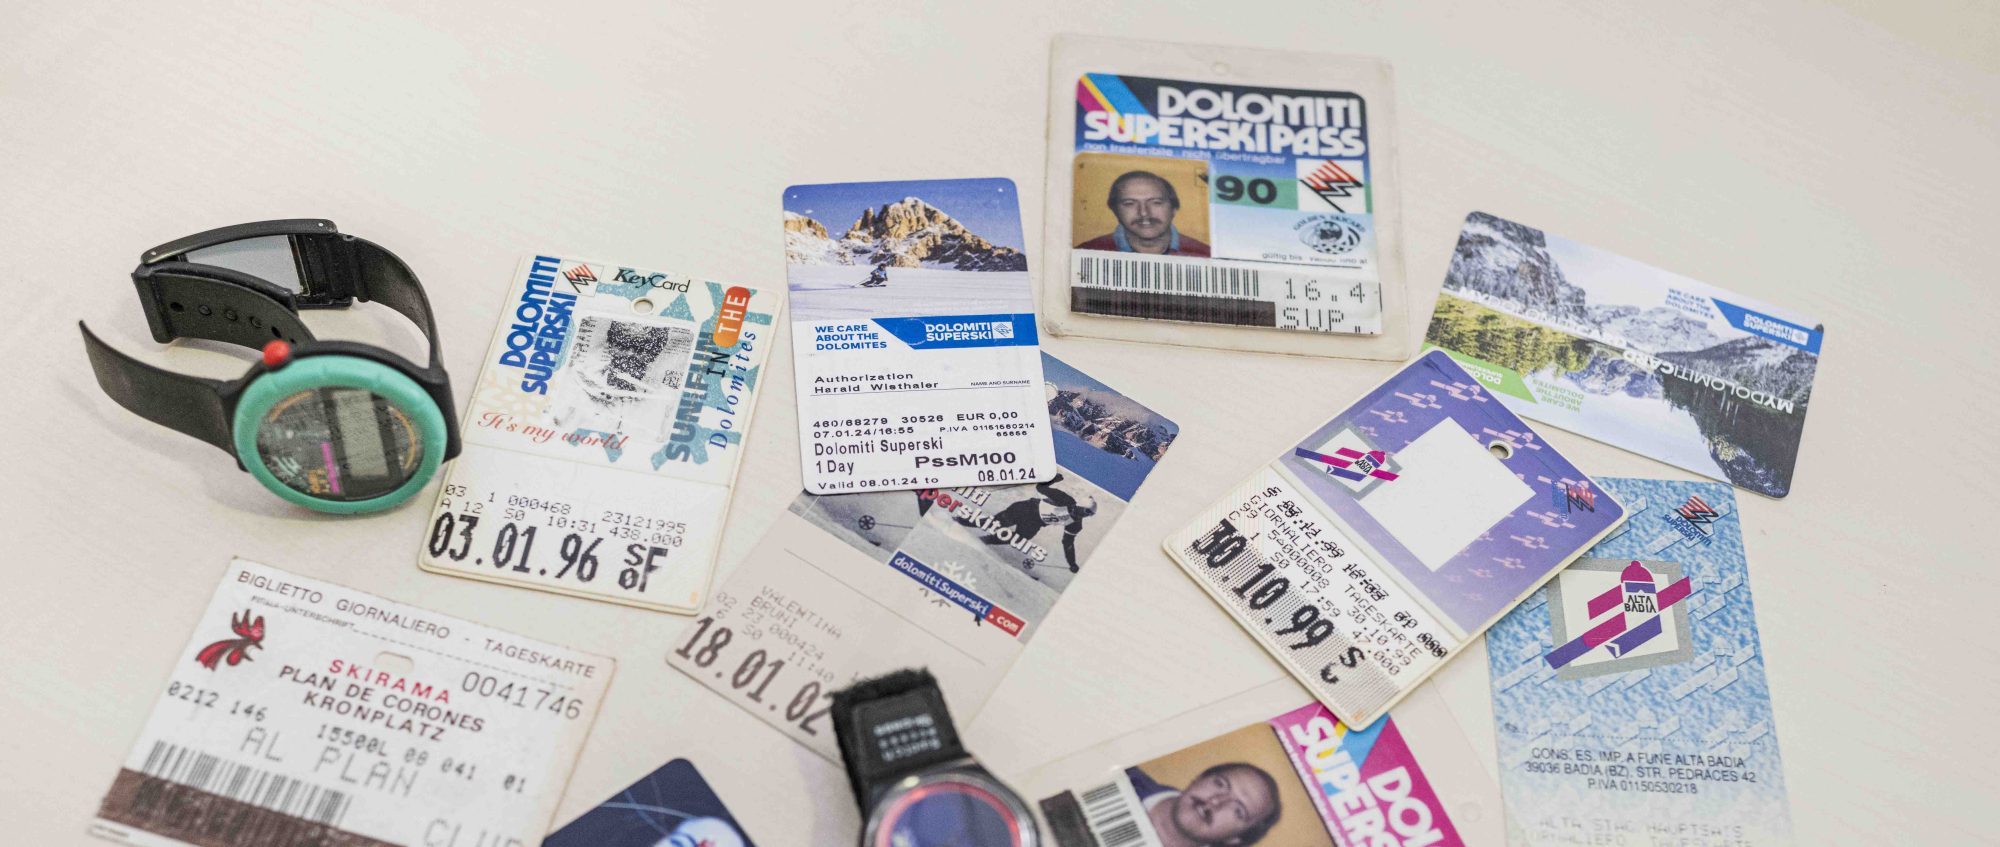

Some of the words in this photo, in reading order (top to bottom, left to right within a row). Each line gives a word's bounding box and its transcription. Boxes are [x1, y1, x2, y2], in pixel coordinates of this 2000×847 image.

[1157, 85, 1361, 128] DOLOMITI
[1215, 174, 1278, 205] 90
[611, 267, 692, 294] KeyCard
[499, 255, 562, 369] DOLOMITI
[718, 294, 748, 334] THE
[814, 325, 835, 333] WE
[837, 324, 868, 332] CARE
[925, 322, 992, 333] DOLOMITI
[521, 293, 578, 395] SUPERSKI
[815, 333, 856, 342] ABOUT
[857, 331, 879, 340] THE
[816, 341, 887, 351] DOLOMITES
[926, 331, 992, 342] SUPERSKI
[706, 350, 731, 378] IN
[814, 372, 914, 384] Authorization
[708, 330, 757, 450] Dolomites
[477, 411, 518, 432] It's
[524, 423, 558, 446] my
[560, 425, 632, 450] world
[957, 413, 985, 421] EUR
[989, 411, 1018, 421] 0,00
[814, 440, 875, 456] Dolomiti
[880, 437, 944, 455] Superski
[815, 461, 822, 474] 1
[827, 459, 854, 476] Day
[914, 451, 1016, 469] PssM100
[818, 480, 854, 490] Valid
[860, 476, 918, 488] 08.01.24
[924, 476, 939, 485] to
[978, 467, 1036, 483] 08.01.24
[444, 484, 467, 497] 03
[508, 494, 572, 516] 000468
[602, 510, 687, 535] 23121995
[463, 501, 484, 514] 12
[547, 516, 598, 534] 10:31
[609, 526, 683, 548] 438.000
[428, 511, 604, 583] 03.01.96
[1250, 494, 1334, 575] GIORNALIERO
[1344, 583, 1423, 660] TAGESKARTE
[750, 595, 798, 629] BRUNI
[1624, 602, 1657, 613] BADIA
[1626, 595, 1652, 604] ALTA
[237, 570, 324, 604] BIGLIETTO
[336, 599, 450, 639] GIORNALIERO
[484, 637, 597, 679] TAGESKARTE
[1299, 579, 1342, 619] 17:59
[1352, 629, 1401, 676] 47.000
[1347, 606, 1412, 668] 30.10.99
[328, 659, 450, 704] SKIRAMA
[461, 671, 584, 721] 0041746
[676, 616, 834, 737] 18.01.02
[279, 665, 337, 692] PLAN
[345, 683, 375, 703] DE
[382, 693, 486, 734] CORONES
[303, 690, 445, 743] KRONPLATZ
[314, 744, 419, 798] PLAN
[1525, 761, 1561, 774] 39036
[1564, 762, 1601, 776] BADIA
[1669, 768, 1738, 783] PEDRACES
[1741, 771, 1757, 784] 42
[1532, 748, 1571, 761] CONS.
[1627, 753, 1636, 763] A
[1638, 753, 1673, 766] FUNE
[1675, 754, 1705, 767] ALTA
[1708, 756, 1746, 769] BADIA
